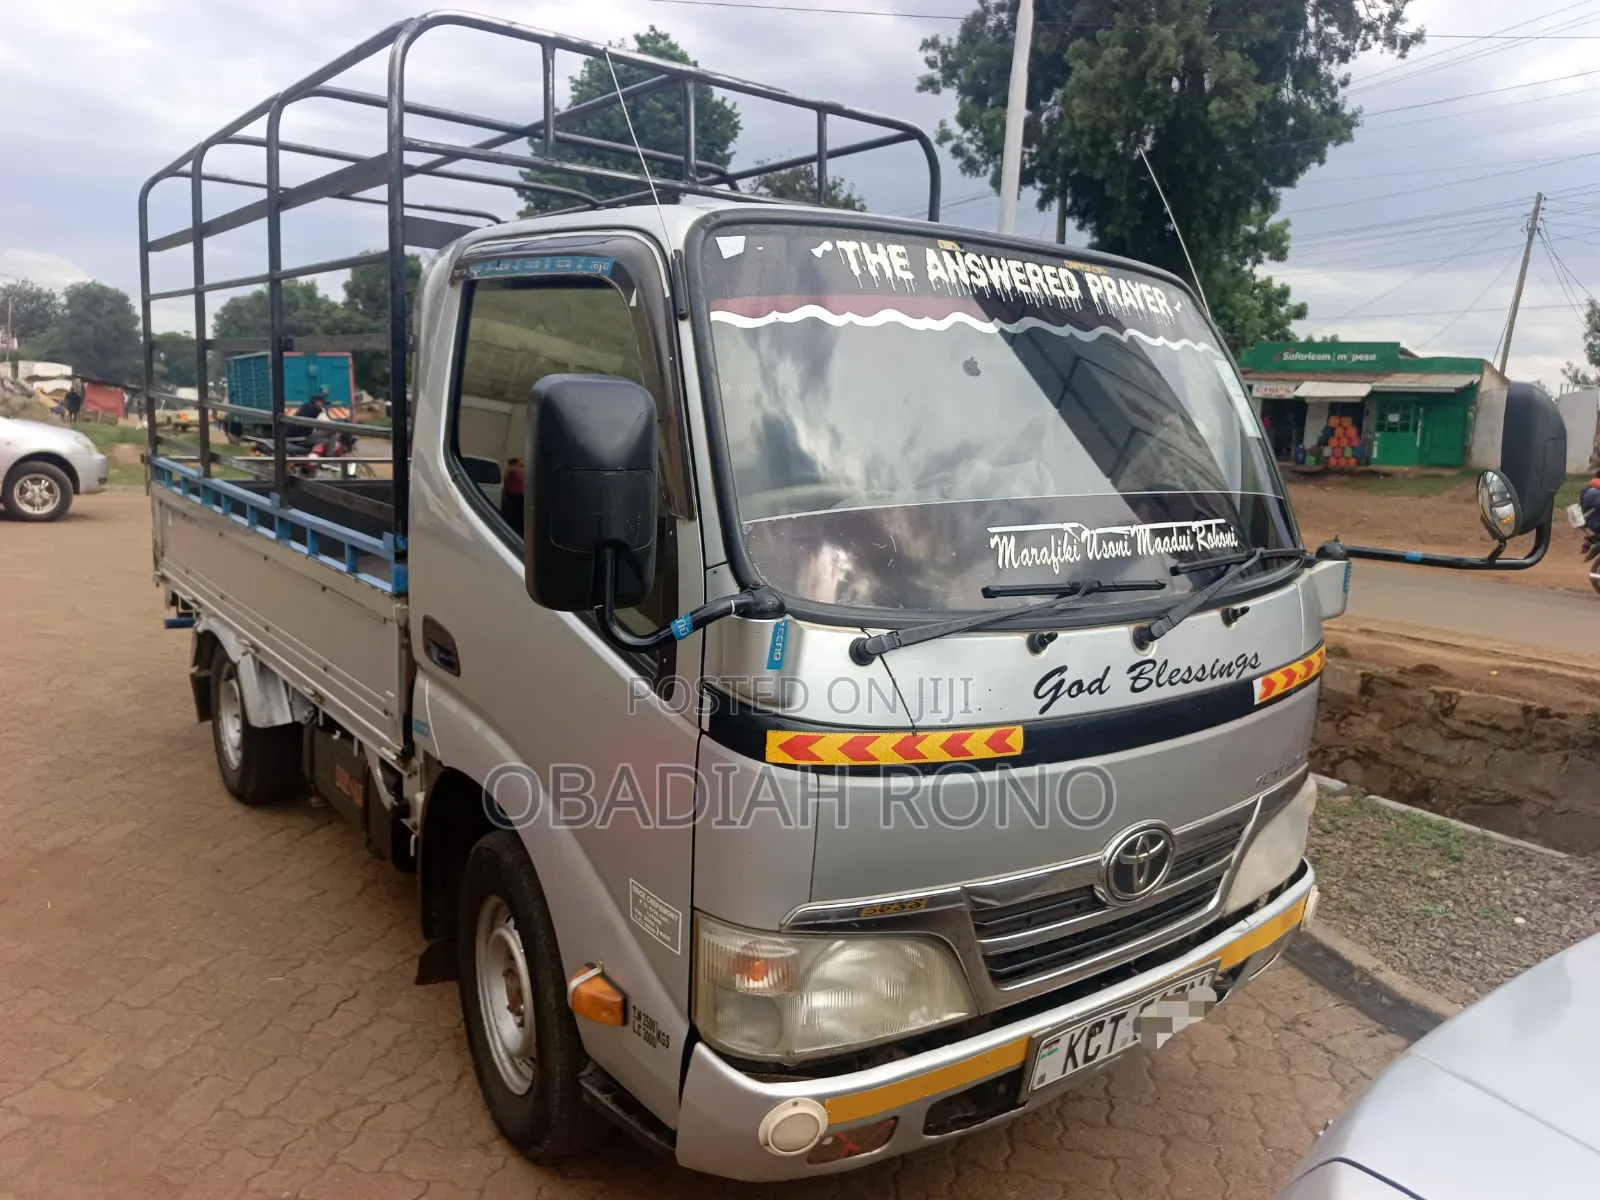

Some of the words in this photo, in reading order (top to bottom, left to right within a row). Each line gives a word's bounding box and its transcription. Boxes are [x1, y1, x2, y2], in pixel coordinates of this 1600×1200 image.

[836, 240, 916, 288] THE
[925, 247, 1083, 309] ANSWERED
[1084, 272, 1175, 325] PRAYER
[1282, 351, 1331, 361] Safaricom
[989, 531, 1080, 574] Marafiki
[1130, 524, 1193, 556] Maadui
[1033, 664, 1110, 715] God
[1126, 652, 1261, 694] Blessings
[643, 1012, 656, 1034] 2500
[657, 1028, 670, 1049] KGS
[1062, 1011, 1128, 1075] KCT
